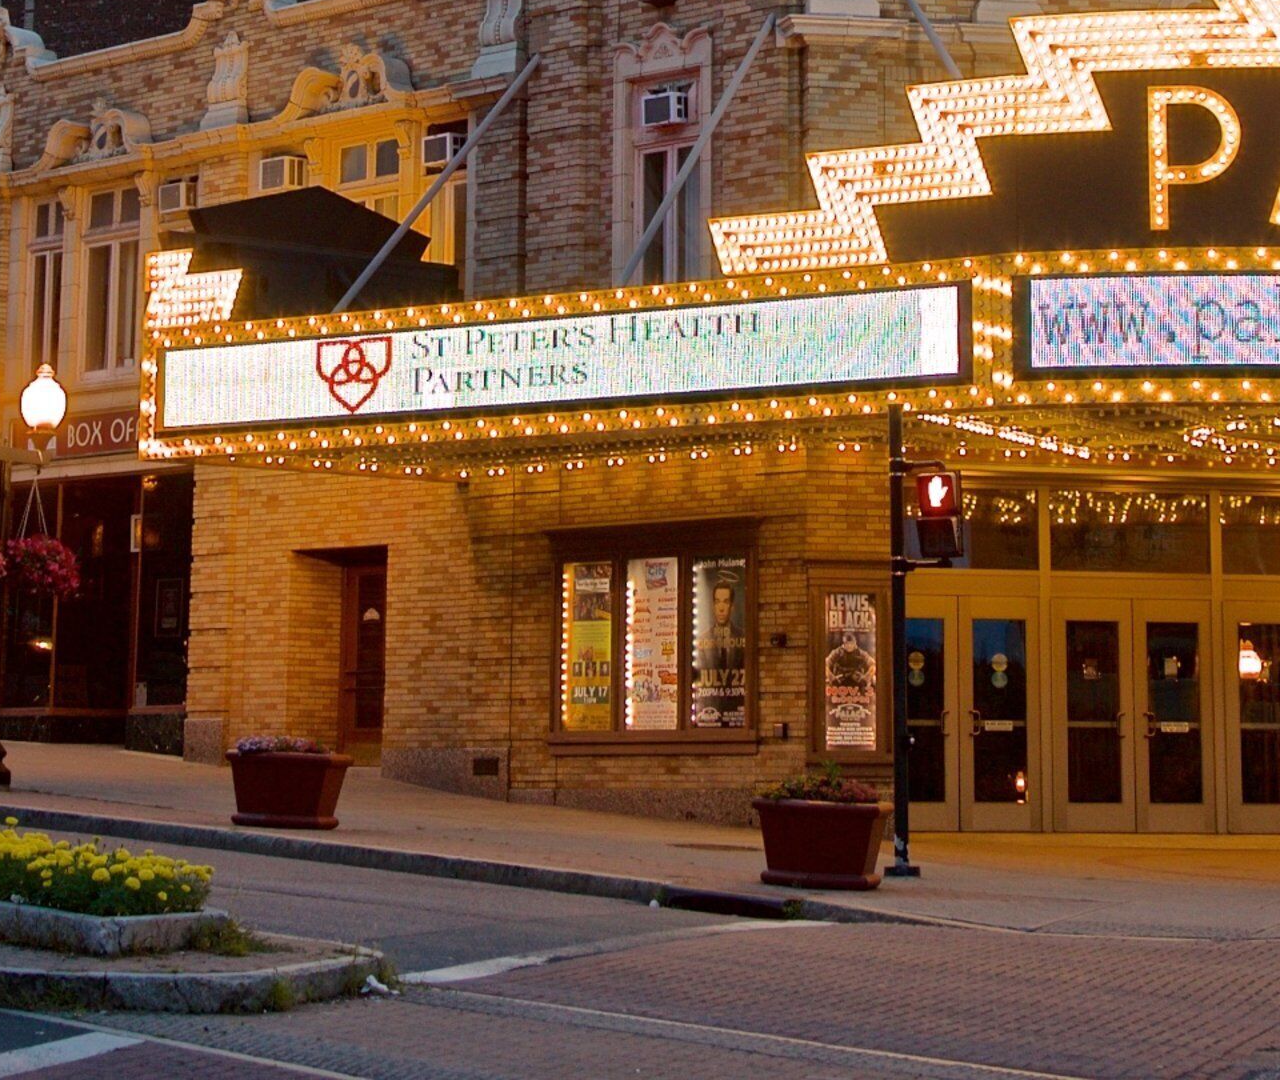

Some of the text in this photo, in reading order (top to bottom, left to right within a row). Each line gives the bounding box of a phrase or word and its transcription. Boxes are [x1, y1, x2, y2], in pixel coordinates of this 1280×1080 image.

[610, 311, 762, 344] HEALTH
[413, 362, 588, 397] PARTNERS
[67, 421, 103, 448] BOX
[830, 593, 869, 610] LEWIS
[829, 610, 870, 628] BLACK
[698, 669, 730, 687] JULY
[574, 686, 608, 697] JULY 17
